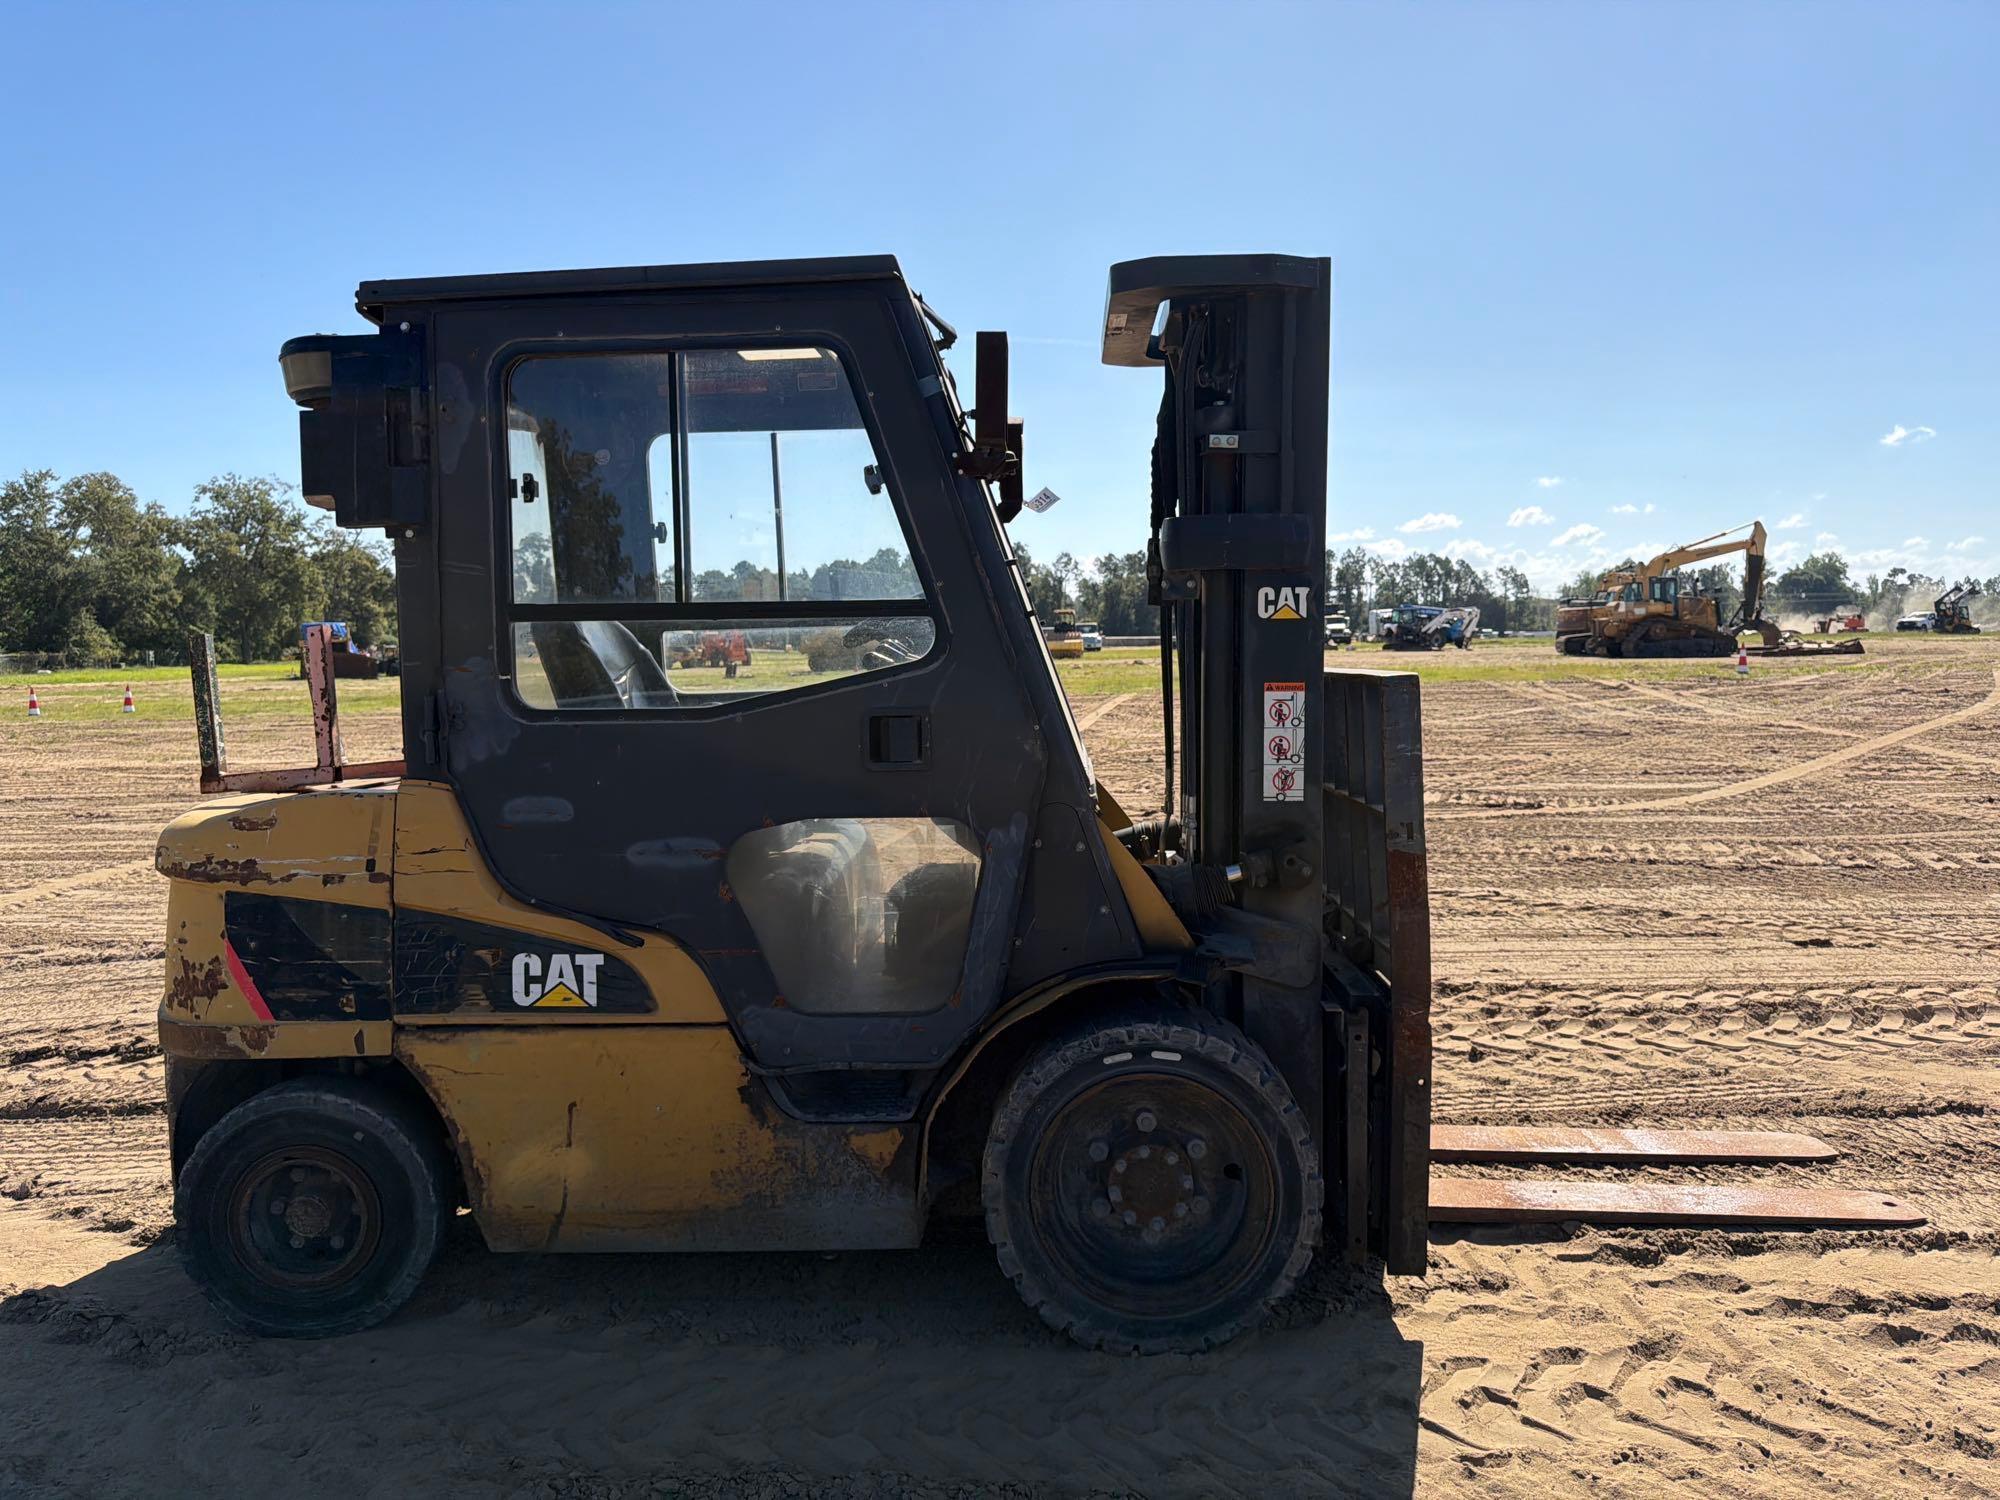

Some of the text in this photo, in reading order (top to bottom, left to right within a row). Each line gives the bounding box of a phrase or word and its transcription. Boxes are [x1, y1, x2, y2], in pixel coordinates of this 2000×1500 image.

[1257, 586, 1310, 619] CAT
[1275, 684, 1304, 692] WARNING
[511, 952, 604, 1007] CAT
